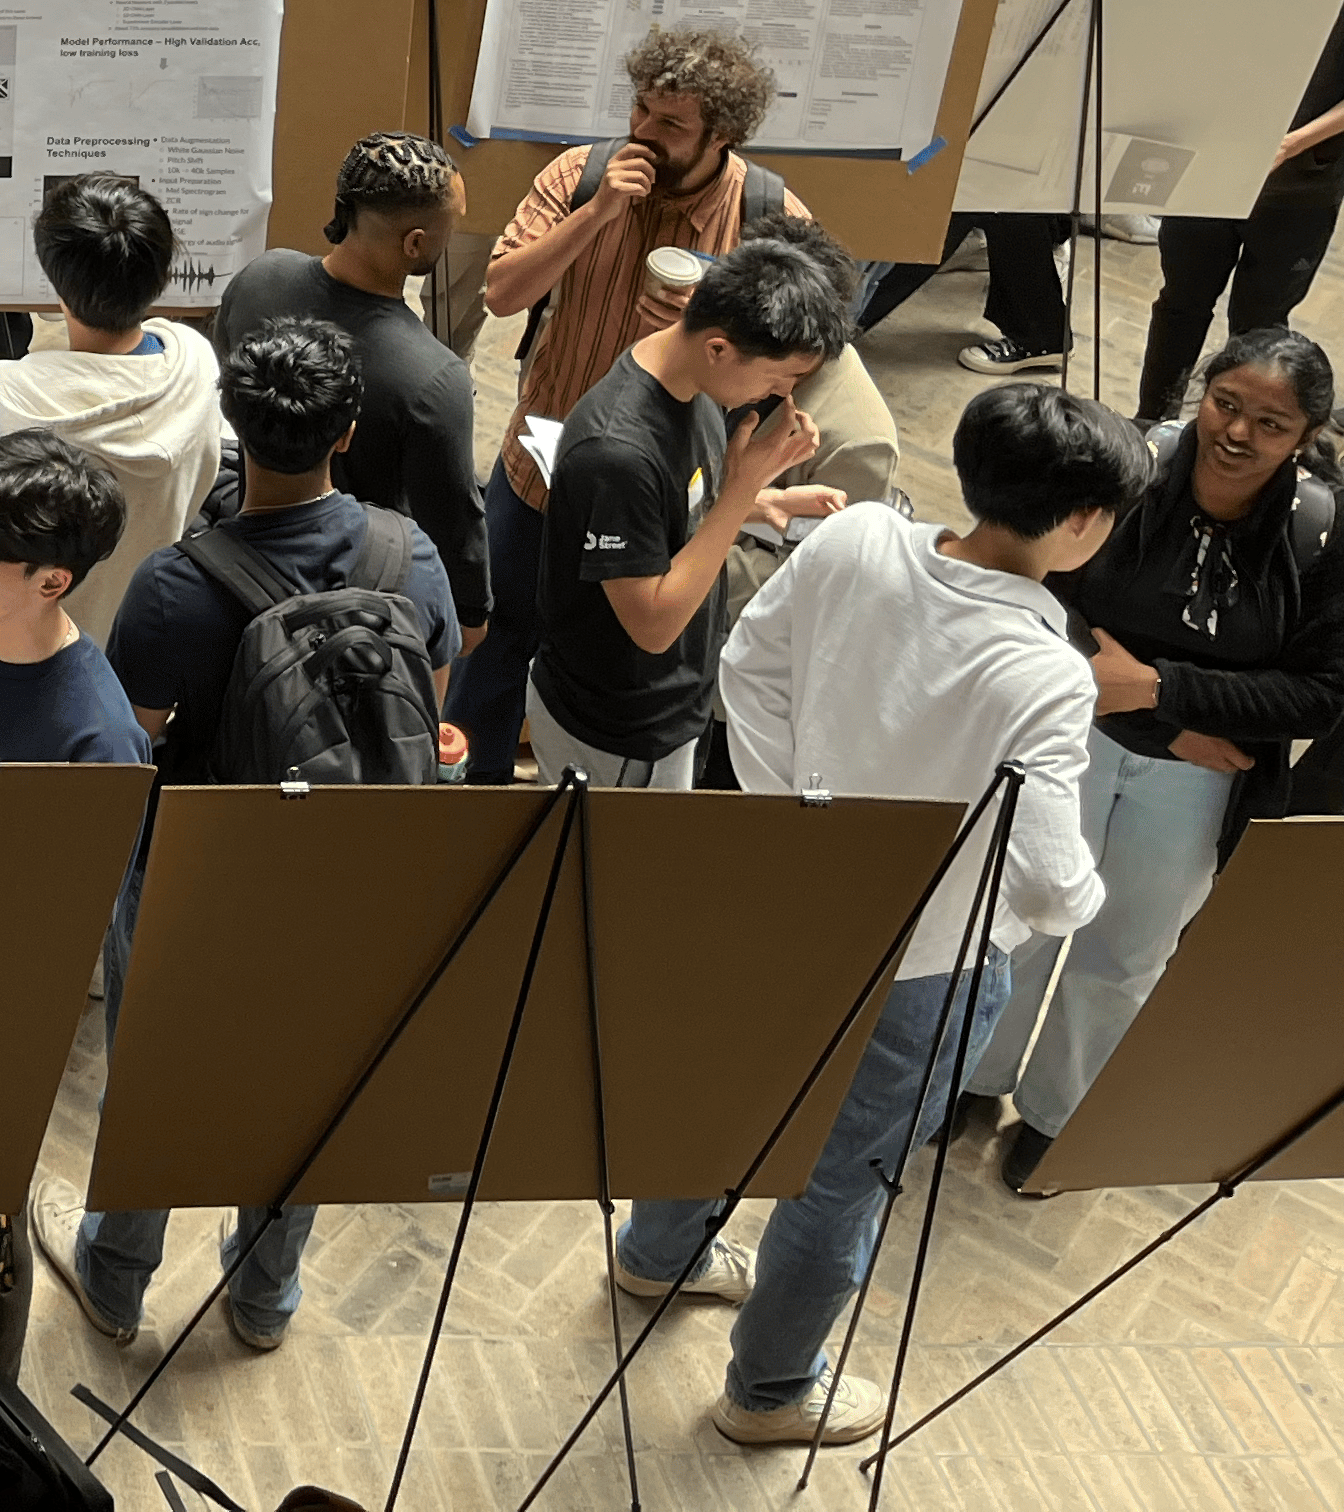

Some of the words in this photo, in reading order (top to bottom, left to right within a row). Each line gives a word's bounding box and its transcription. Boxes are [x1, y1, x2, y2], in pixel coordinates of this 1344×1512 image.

[61, 38, 89, 46] Model
[92, 38, 153, 46] Performance
[164, 38, 187, 46] High
[190, 38, 237, 46] Validation
[79, 49, 116, 58] training
[47, 137, 71, 146] Data
[74, 137, 150, 147] Preprocessing
[161, 136, 177, 144] Data
[180, 137, 230, 145] Augmentation
[46, 149, 106, 159] Techniques
[159, 177, 177, 185] Input
[179, 177, 221, 186] Preparation
[166, 187, 179, 195] Mel
[181, 188, 226, 196] Spectrogram
[599, 534, 621, 543] Jane
[599, 541, 628, 549] Street
